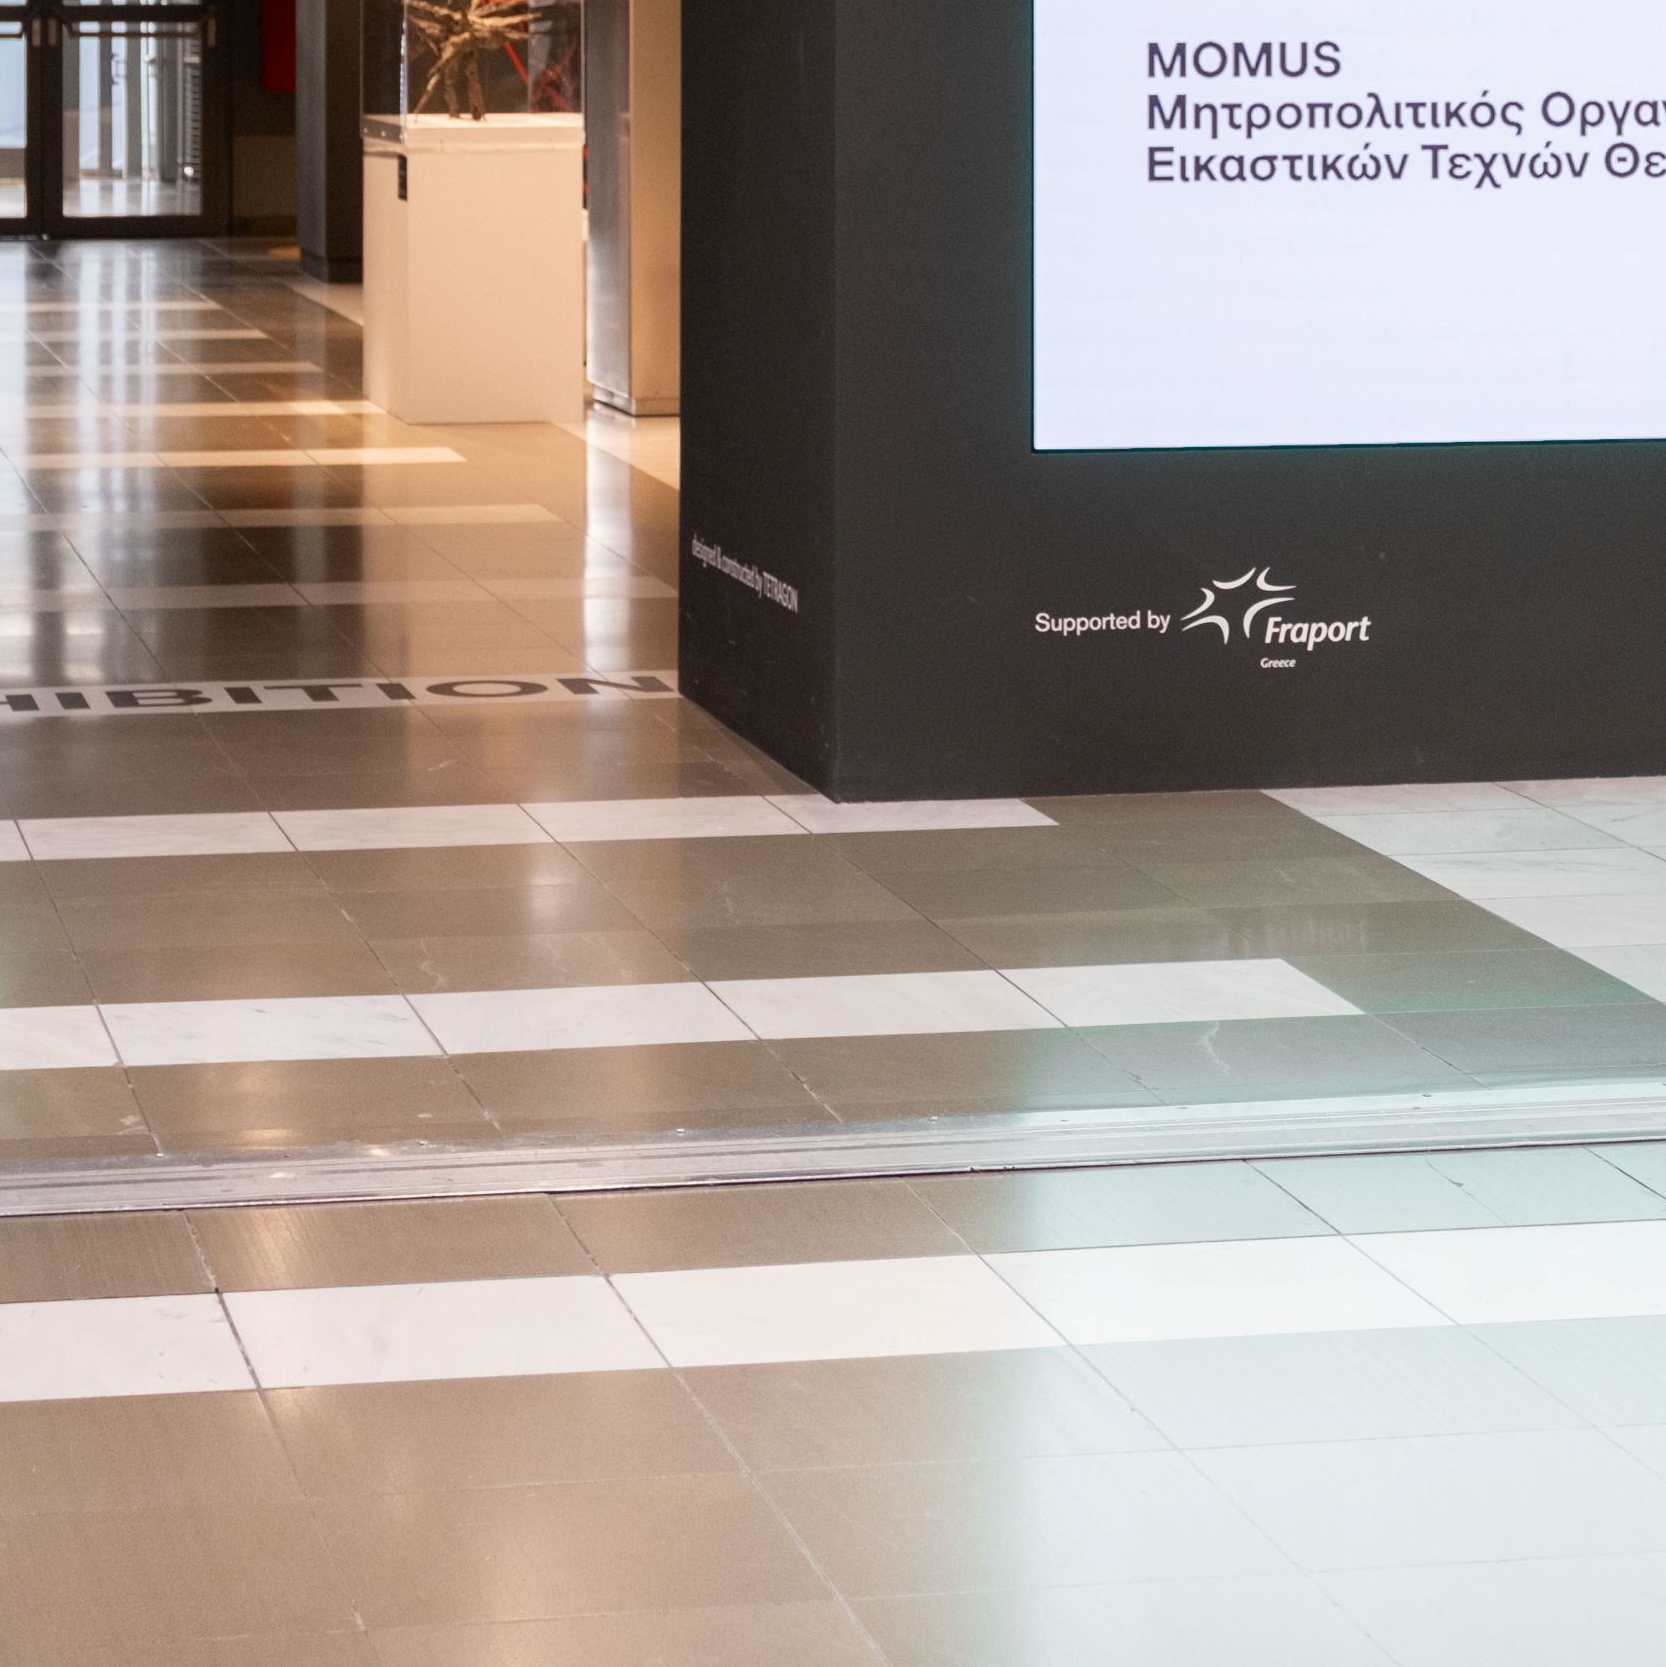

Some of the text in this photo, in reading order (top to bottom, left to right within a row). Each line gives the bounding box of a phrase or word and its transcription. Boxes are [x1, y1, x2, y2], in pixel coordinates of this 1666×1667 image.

[1146, 40, 1343, 79] MOMUS
[1146, 90, 1526, 138] Μητροπολιτικός
[1146, 142, 1409, 184] Εικαστικών
[1421, 141, 1590, 191] Τεχνών
[1035, 610, 1372, 651] Supported by Fraport
[1260, 658, 1297, 669] Greece
